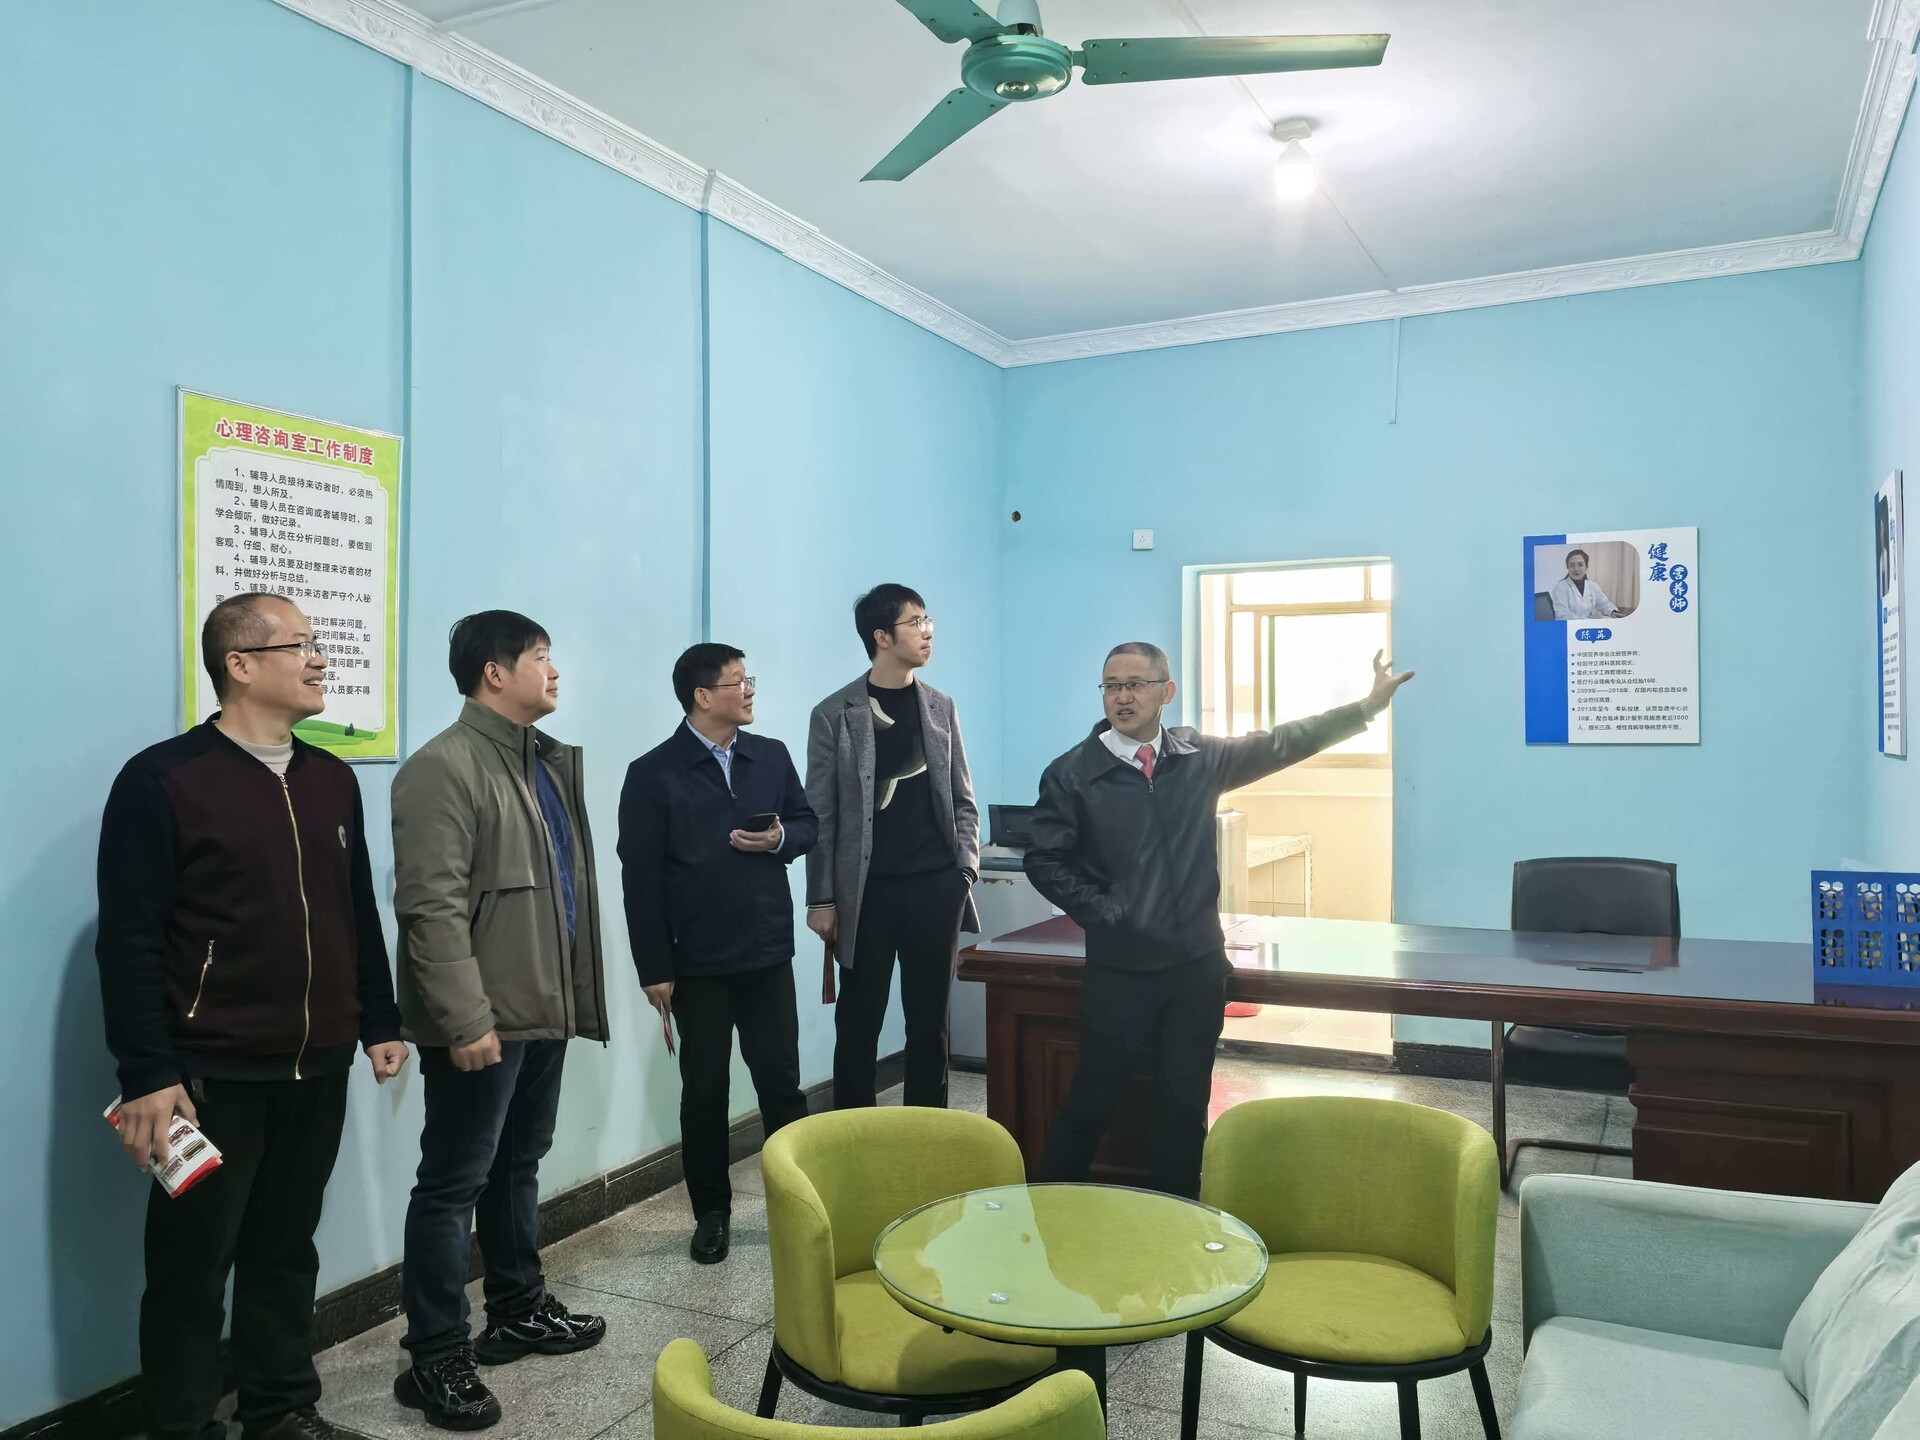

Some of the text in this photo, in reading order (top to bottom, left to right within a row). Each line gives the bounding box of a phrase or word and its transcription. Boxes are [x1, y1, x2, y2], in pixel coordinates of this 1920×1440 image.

[215, 418, 374, 466] 心理咨询室工作制度
[215, 479, 294, 500] 情周到，想人所及。
[215, 508, 302, 529] 学会倾听，做好记录。
[1647, 542, 1669, 582] 健康
[1671, 566, 1687, 610] 营养师
